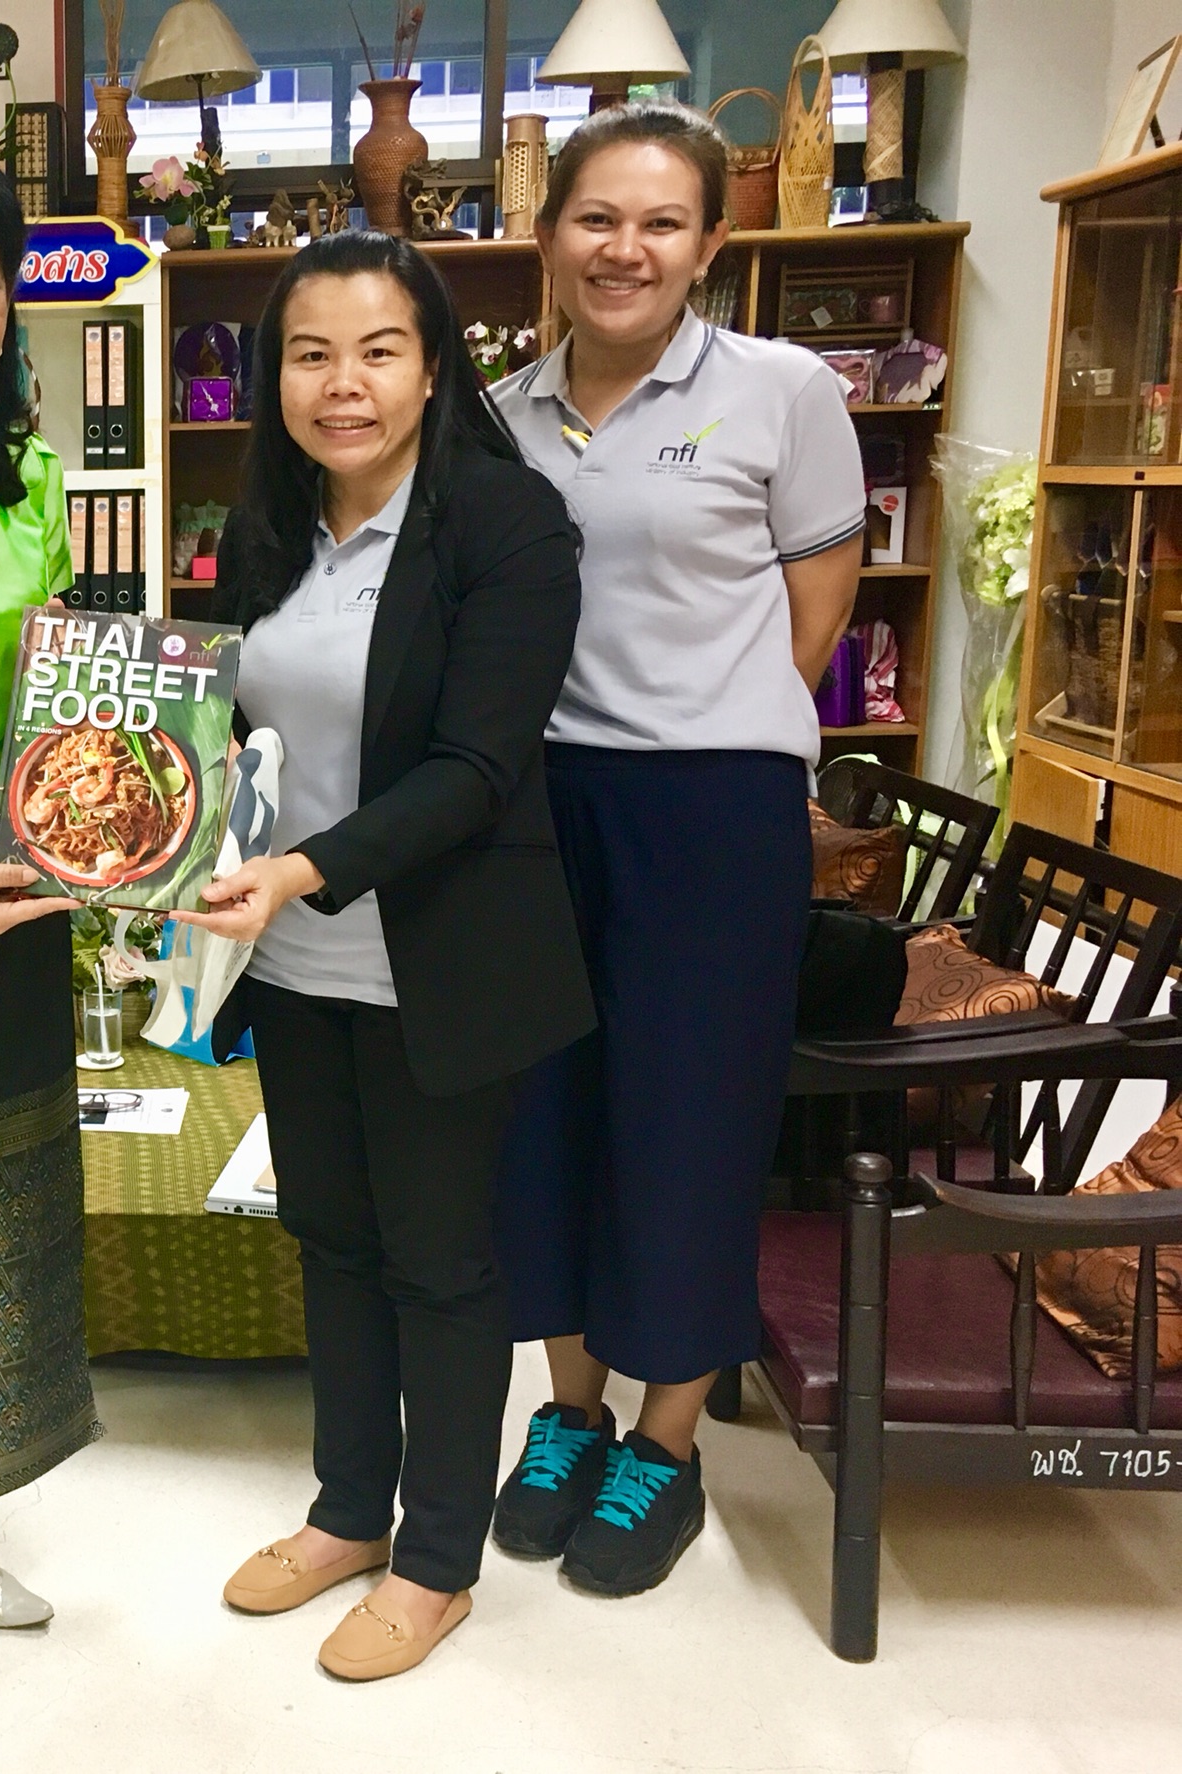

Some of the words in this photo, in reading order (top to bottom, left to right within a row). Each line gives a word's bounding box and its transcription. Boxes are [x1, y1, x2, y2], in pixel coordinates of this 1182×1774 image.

[659, 442, 698, 462] nfi
[34, 616, 145, 660] THAI
[27, 652, 218, 702] STREET
[22, 687, 158, 732] FOOD
